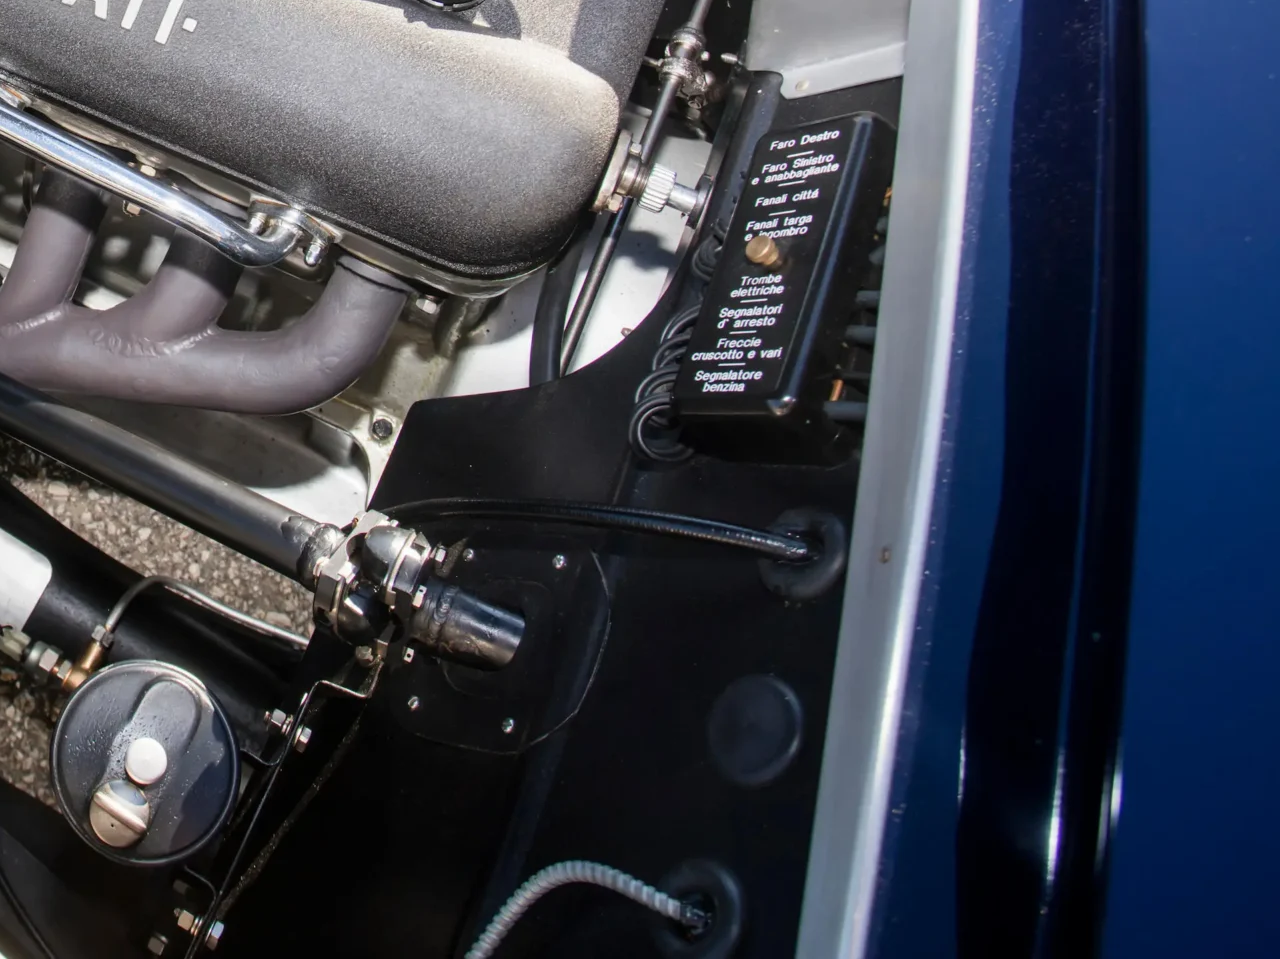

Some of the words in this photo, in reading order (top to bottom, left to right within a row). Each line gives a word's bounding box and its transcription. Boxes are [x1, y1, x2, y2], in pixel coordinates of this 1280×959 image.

[770, 140, 796, 151] Faro
[800, 130, 840, 145] Destro
[762, 163, 788, 174] Faro
[792, 154, 835, 168] Sinistro
[751, 177, 760, 185] e
[764, 163, 839, 183] anabbagliante
[755, 194, 788, 207] Fanali
[746, 218, 779, 231] Fanali
[784, 215, 813, 227] targa
[741, 274, 783, 286] Trombe
[730, 285, 785, 298] elettriche
[719, 303, 784, 319] Segnalatori
[733, 316, 776, 328] arresto
[716, 337, 762, 348] Freccie
[691, 349, 744, 361] cruscotto
[747, 350, 756, 359] e
[760, 347, 783, 358] vari
[694, 370, 763, 383] Segnalatore
[702, 382, 746, 392] benzina
